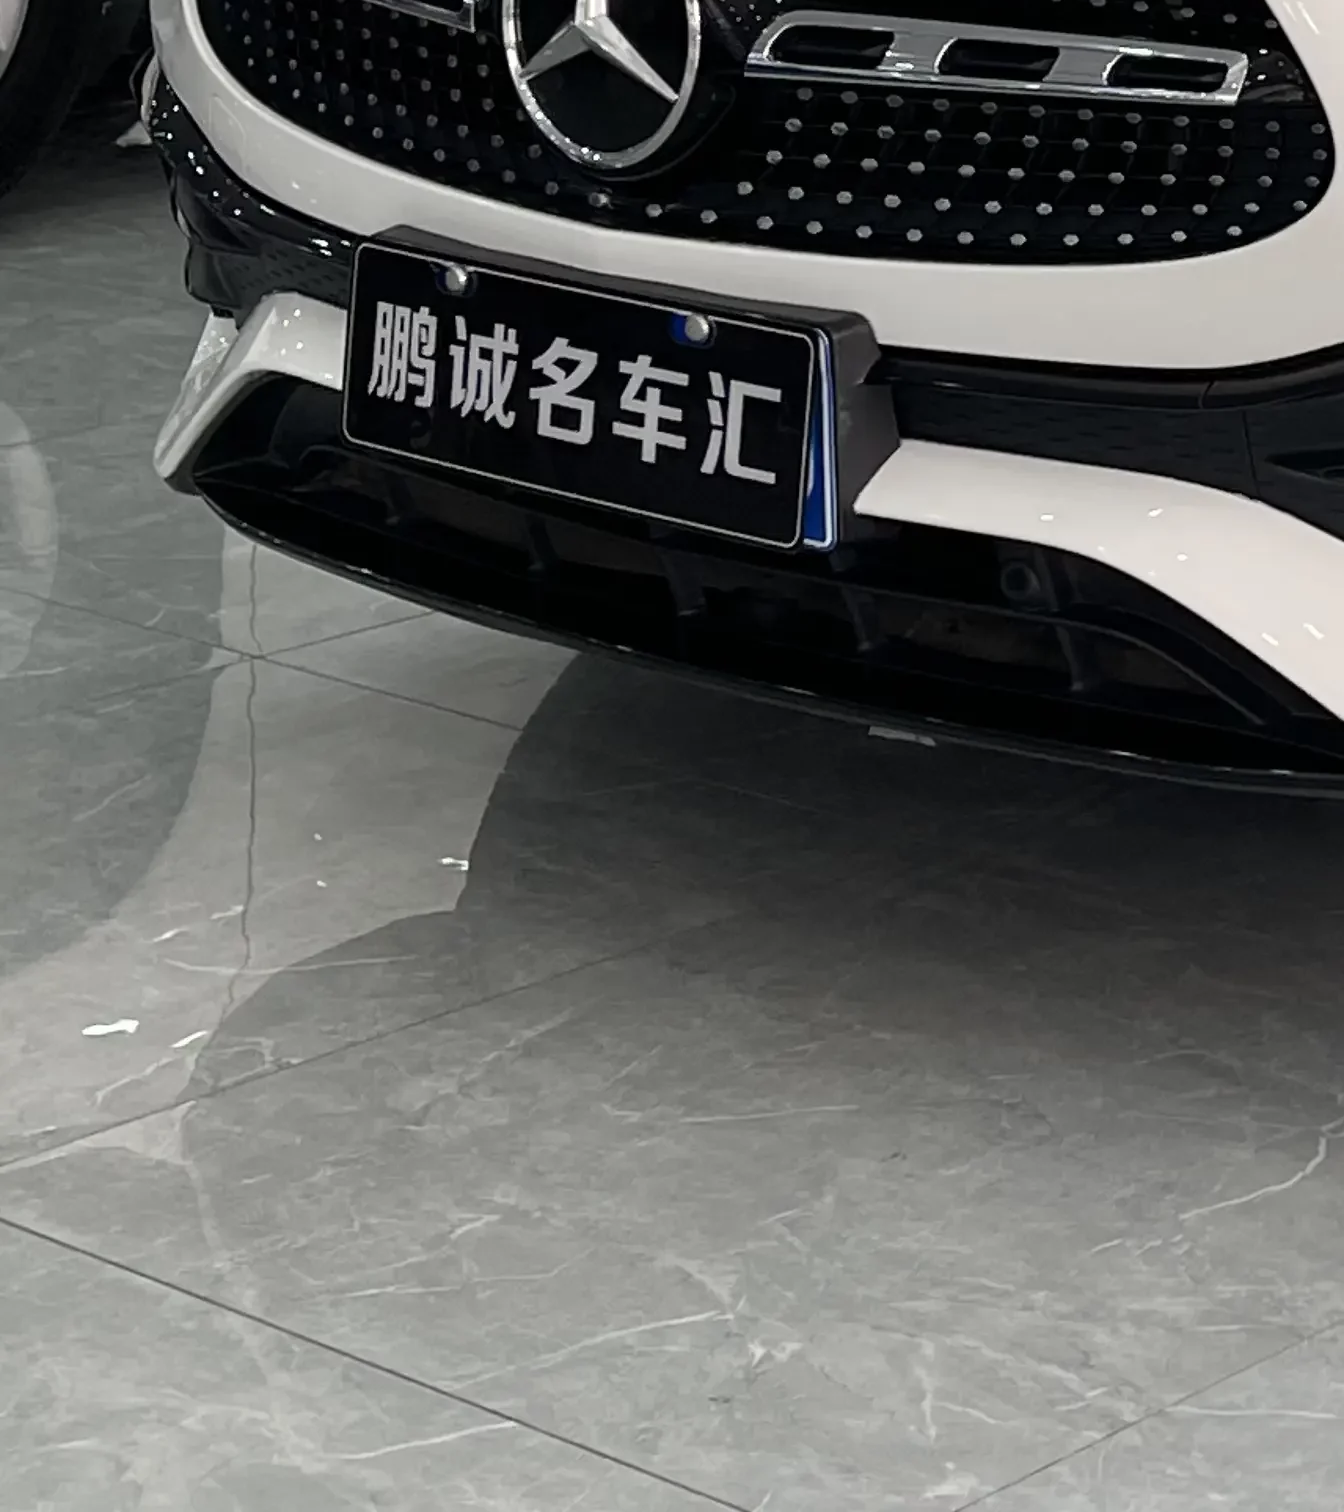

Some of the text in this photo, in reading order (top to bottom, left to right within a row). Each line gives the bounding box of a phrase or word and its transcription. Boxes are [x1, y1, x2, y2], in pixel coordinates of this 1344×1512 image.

[368, 300, 782, 485] 鹏诚名车汇
